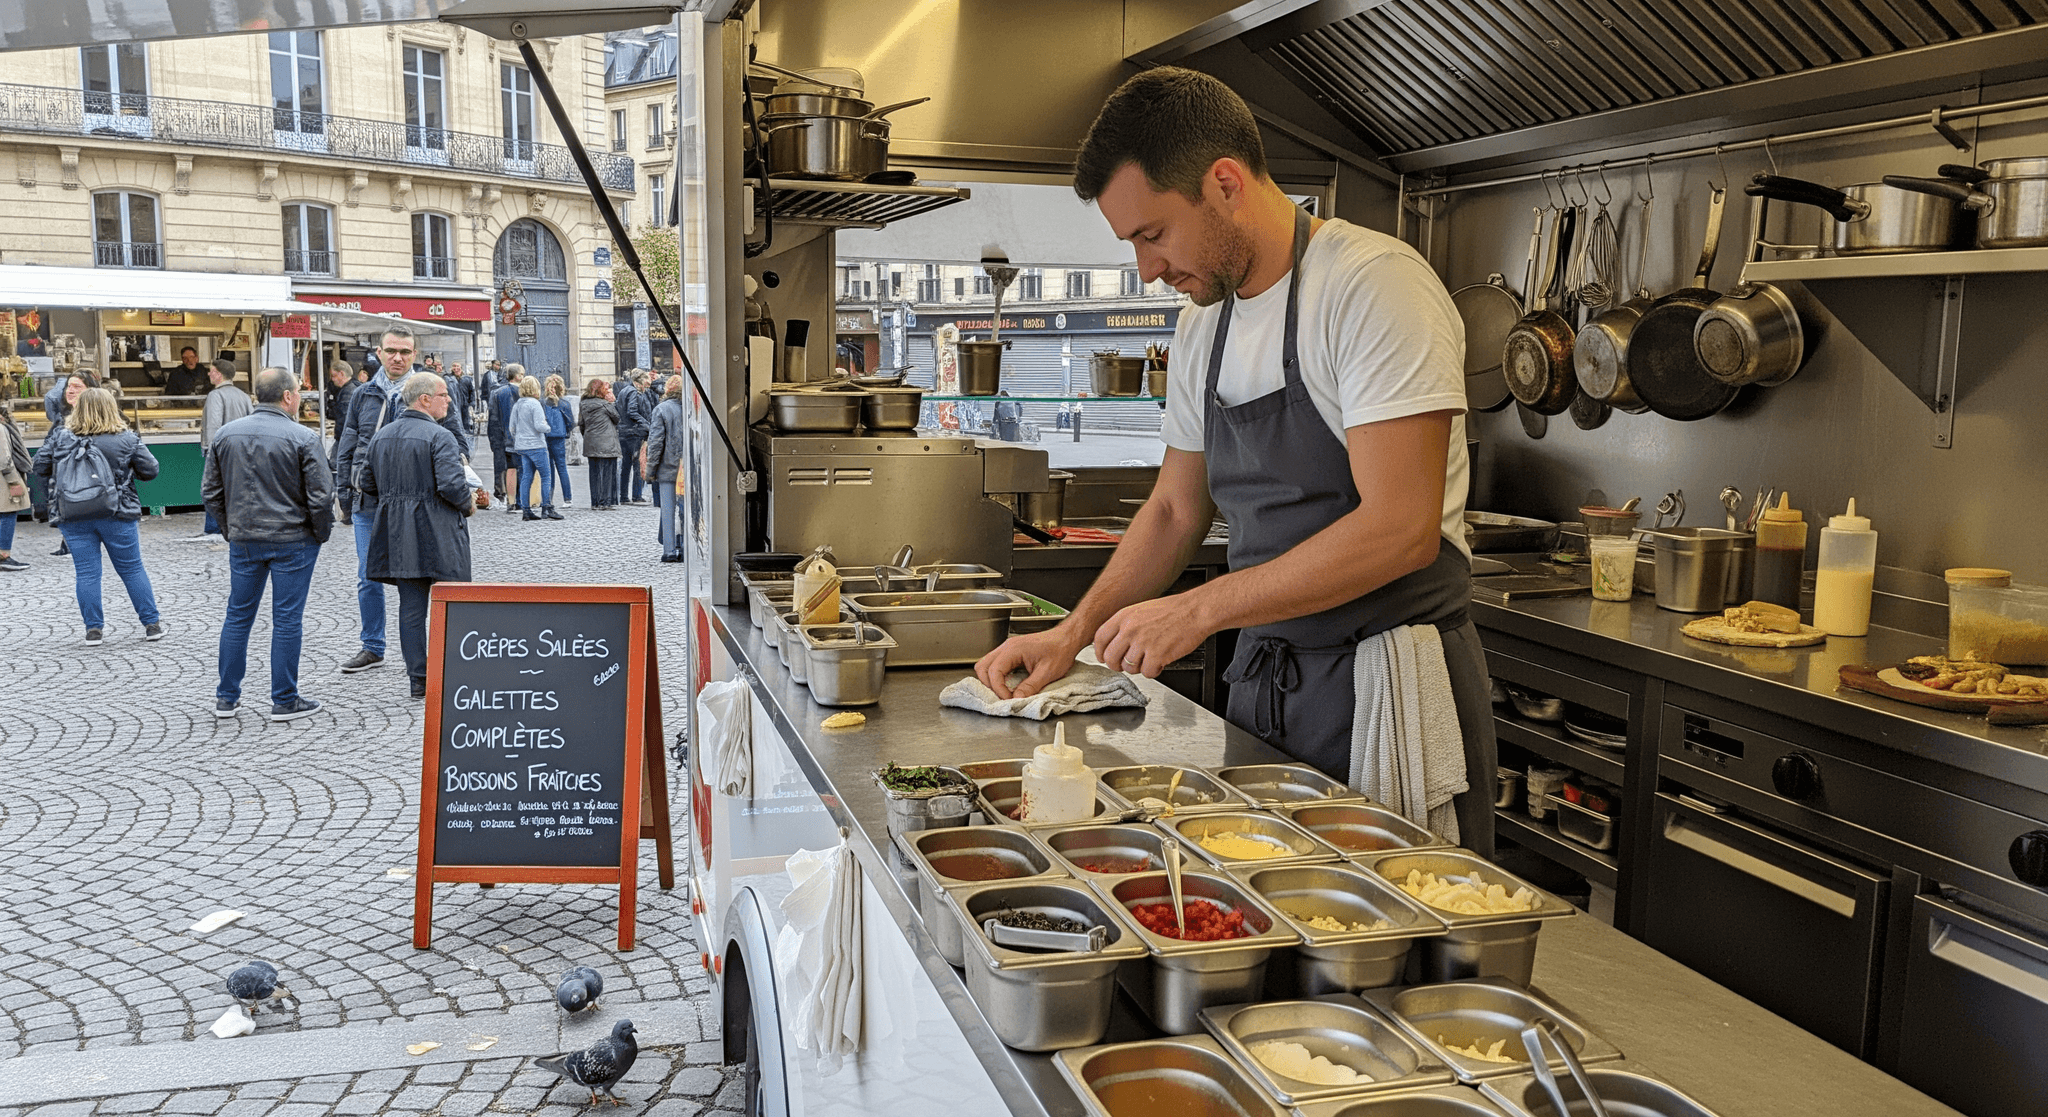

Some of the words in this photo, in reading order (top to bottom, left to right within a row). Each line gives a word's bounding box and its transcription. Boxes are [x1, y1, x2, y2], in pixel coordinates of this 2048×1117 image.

[453, 685, 559, 711] GALETTES
[451, 721, 565, 750] COMPLÈTES
[444, 765, 518, 792] BOISSONS
